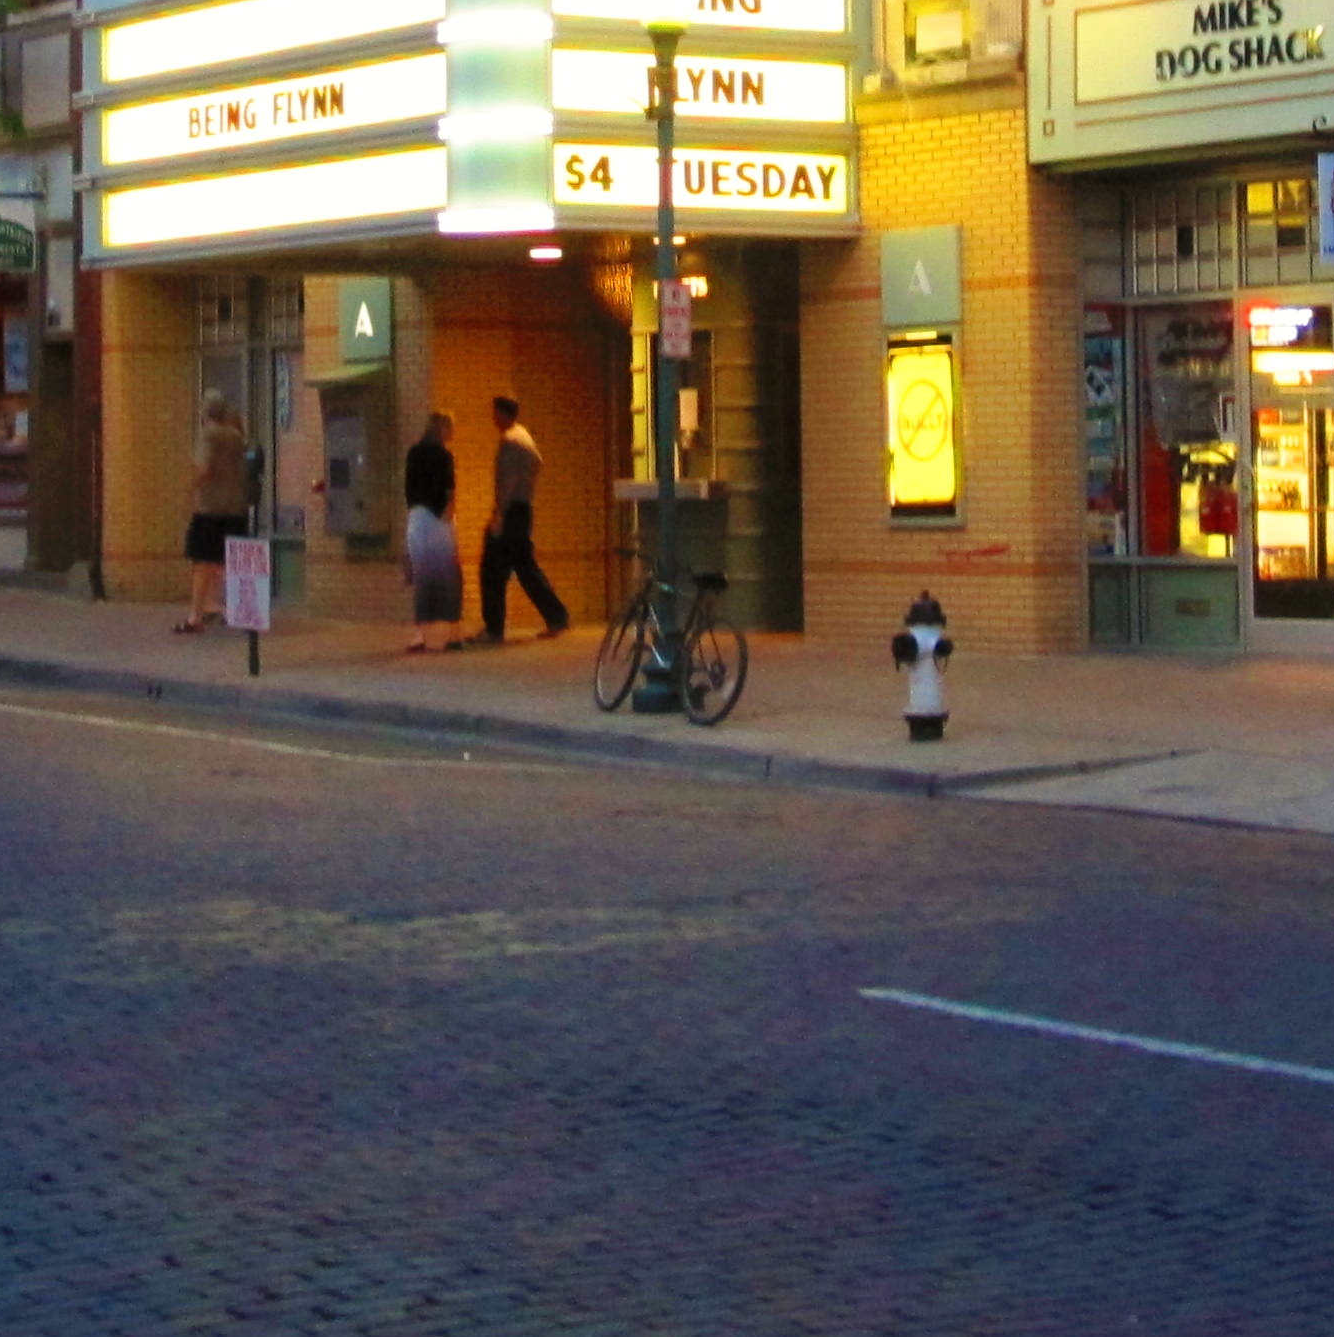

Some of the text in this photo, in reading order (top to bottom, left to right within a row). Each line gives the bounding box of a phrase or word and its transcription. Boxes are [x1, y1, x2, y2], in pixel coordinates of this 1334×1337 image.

[1155, 24, 1325, 81] DOG SHACK
[189, 82, 345, 139] BEING FLYNN
[566, 154, 836, 200] $4 UESDAY
[907, 259, 932, 295] A
[354, 301, 374, 339] A
